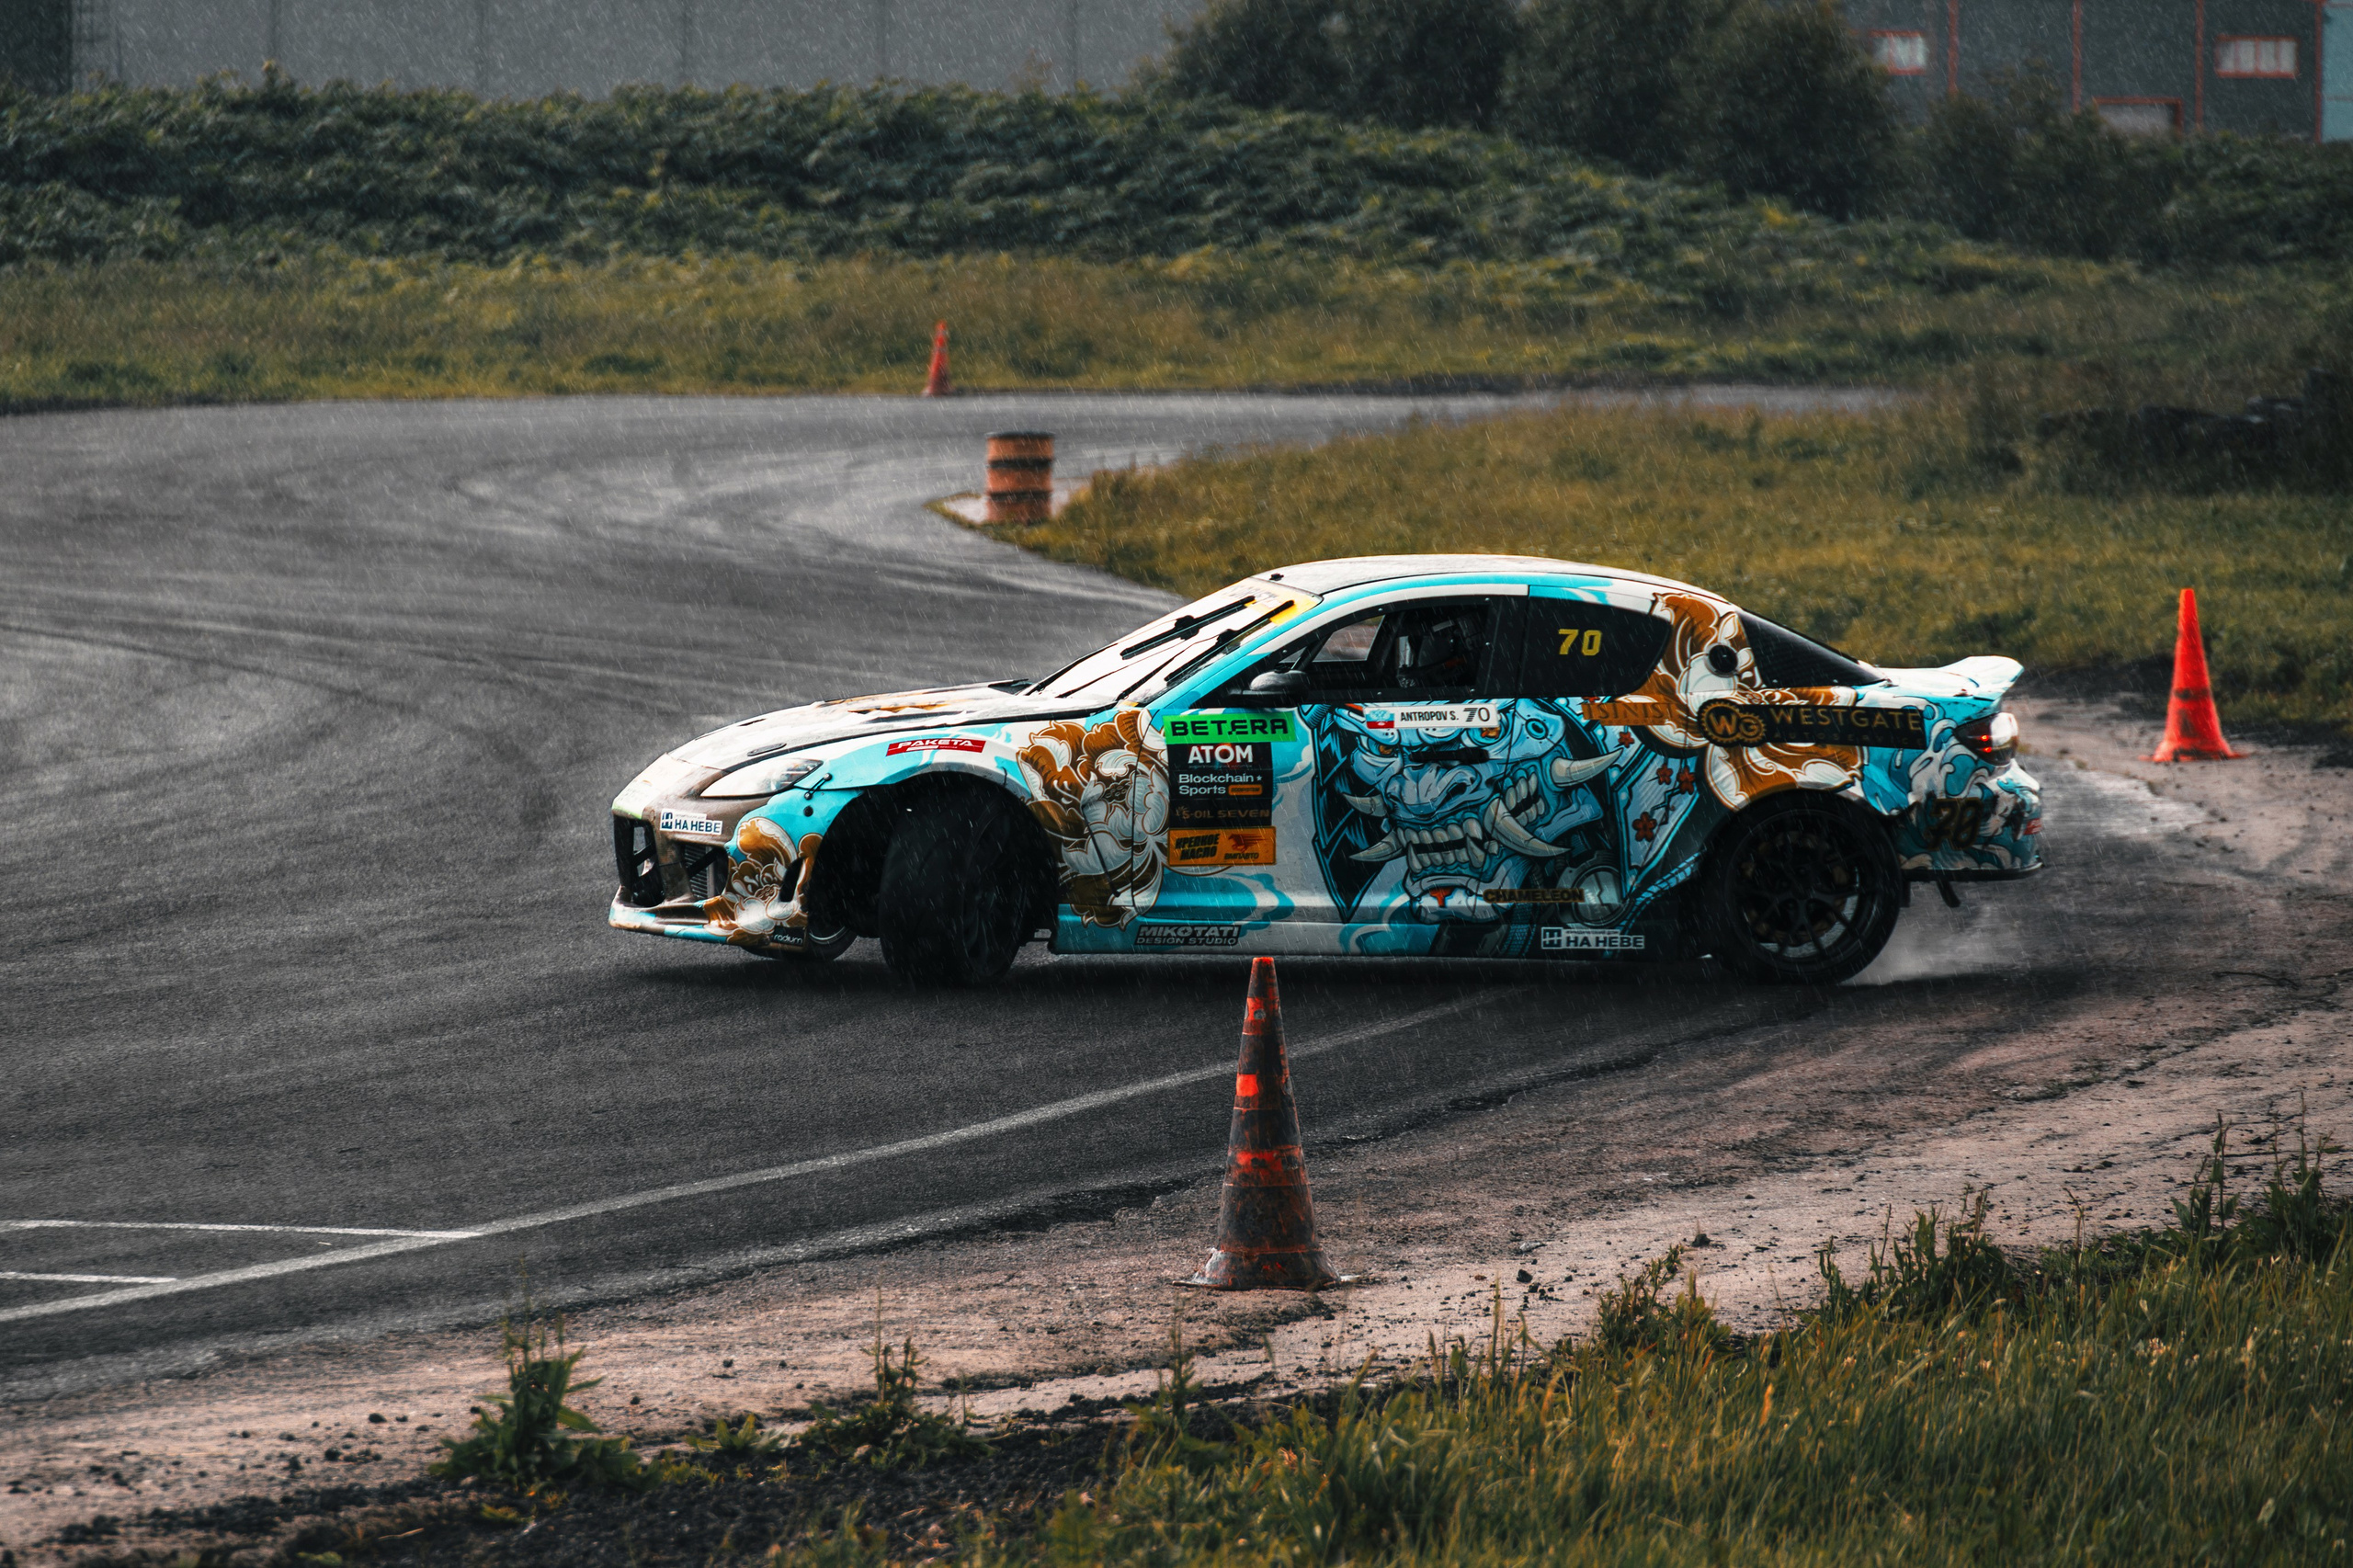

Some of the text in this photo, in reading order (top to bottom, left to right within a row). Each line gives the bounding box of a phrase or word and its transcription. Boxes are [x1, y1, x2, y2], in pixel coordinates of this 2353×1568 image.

[1558, 629, 1603, 656] 70
[1400, 707, 1491, 722] ANTROPOV S. 70
[1768, 707, 1922, 732] WESTGATE
[1170, 718, 1289, 737] BETERA
[1188, 744, 1253, 764] ATOM
[1178, 773, 1255, 783] Blockchain
[1178, 784, 1226, 797] Sports
[1182, 809, 1270, 820] S-OIL SEVEN
[674, 818, 722, 834] НА НЕВЕ
[1927, 798, 1983, 851] 70
[1483, 889, 1583, 902] CHAMELEON
[1138, 926, 1240, 937] MIKOTATI
[1136, 937, 1237, 946] DESIGN STUDIO
[1565, 936, 1643, 948] НА НЕВЕ
